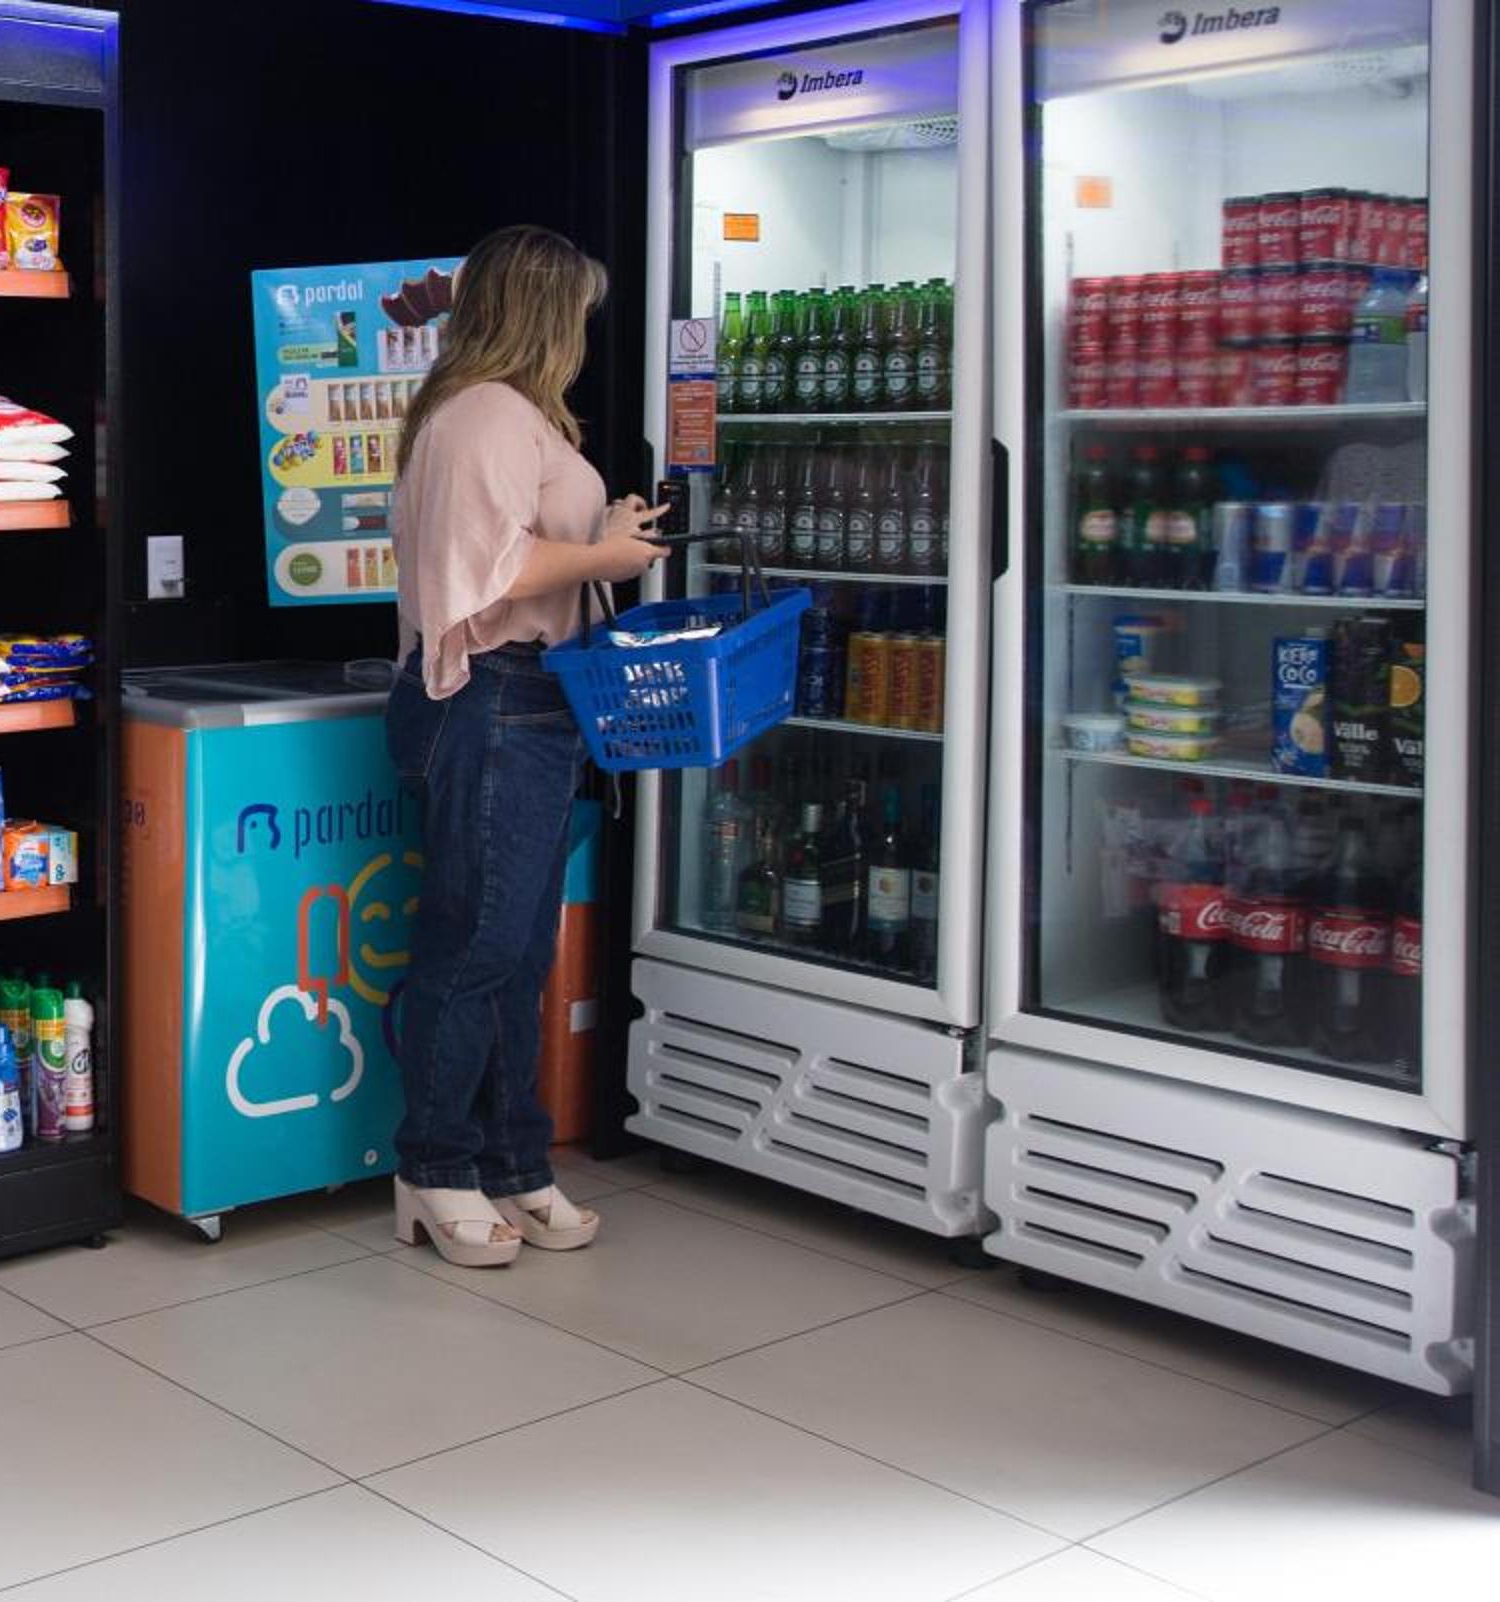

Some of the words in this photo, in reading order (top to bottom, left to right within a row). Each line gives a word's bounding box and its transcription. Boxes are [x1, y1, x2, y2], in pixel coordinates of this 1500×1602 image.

[1190, 6, 1280, 36] Imbera
[800, 69, 864, 94] Imbera
[304, 280, 364, 308] pardal
